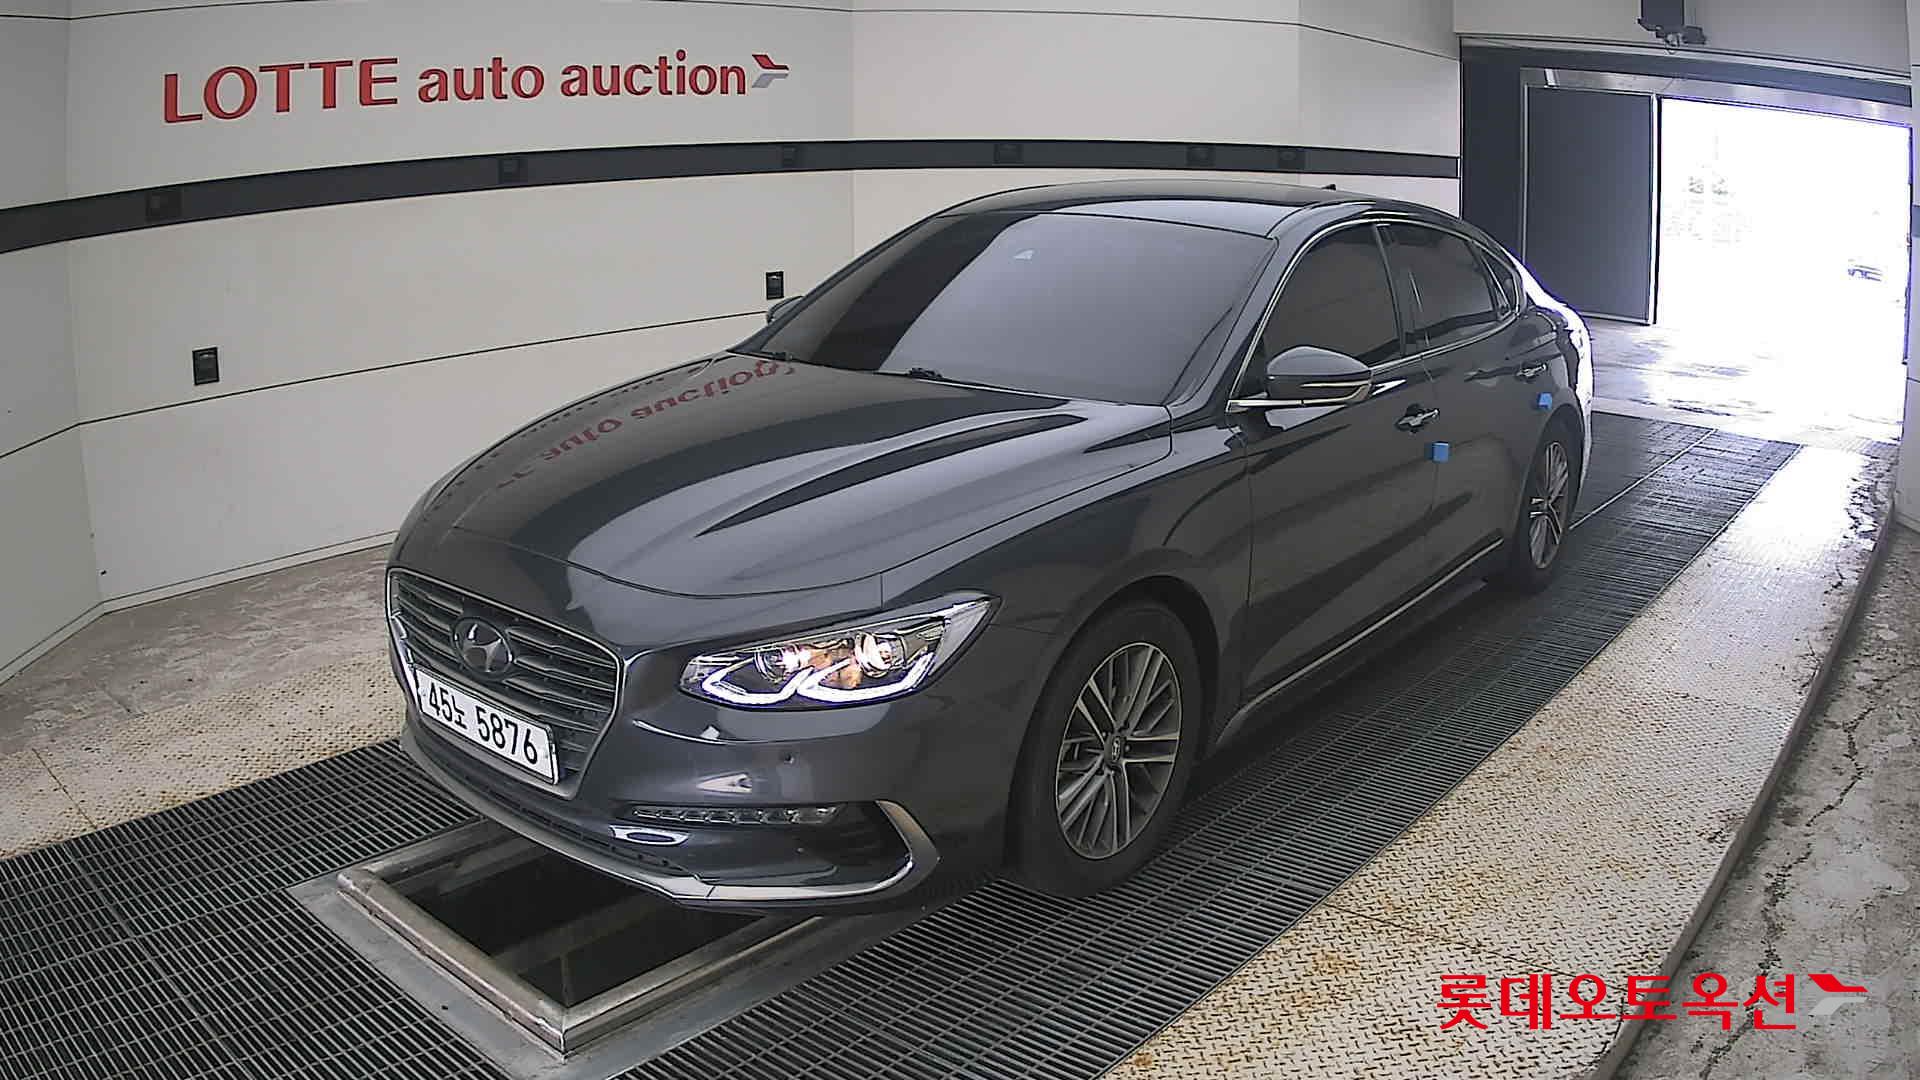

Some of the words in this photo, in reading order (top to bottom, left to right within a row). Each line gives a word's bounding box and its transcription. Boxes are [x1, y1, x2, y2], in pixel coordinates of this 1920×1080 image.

[163, 58, 398, 123] LOTTE
[417, 57, 545, 103] auto
[560, 50, 746, 96] auction
[429, 683, 467, 729] 45노
[475, 706, 538, 765] 5876
